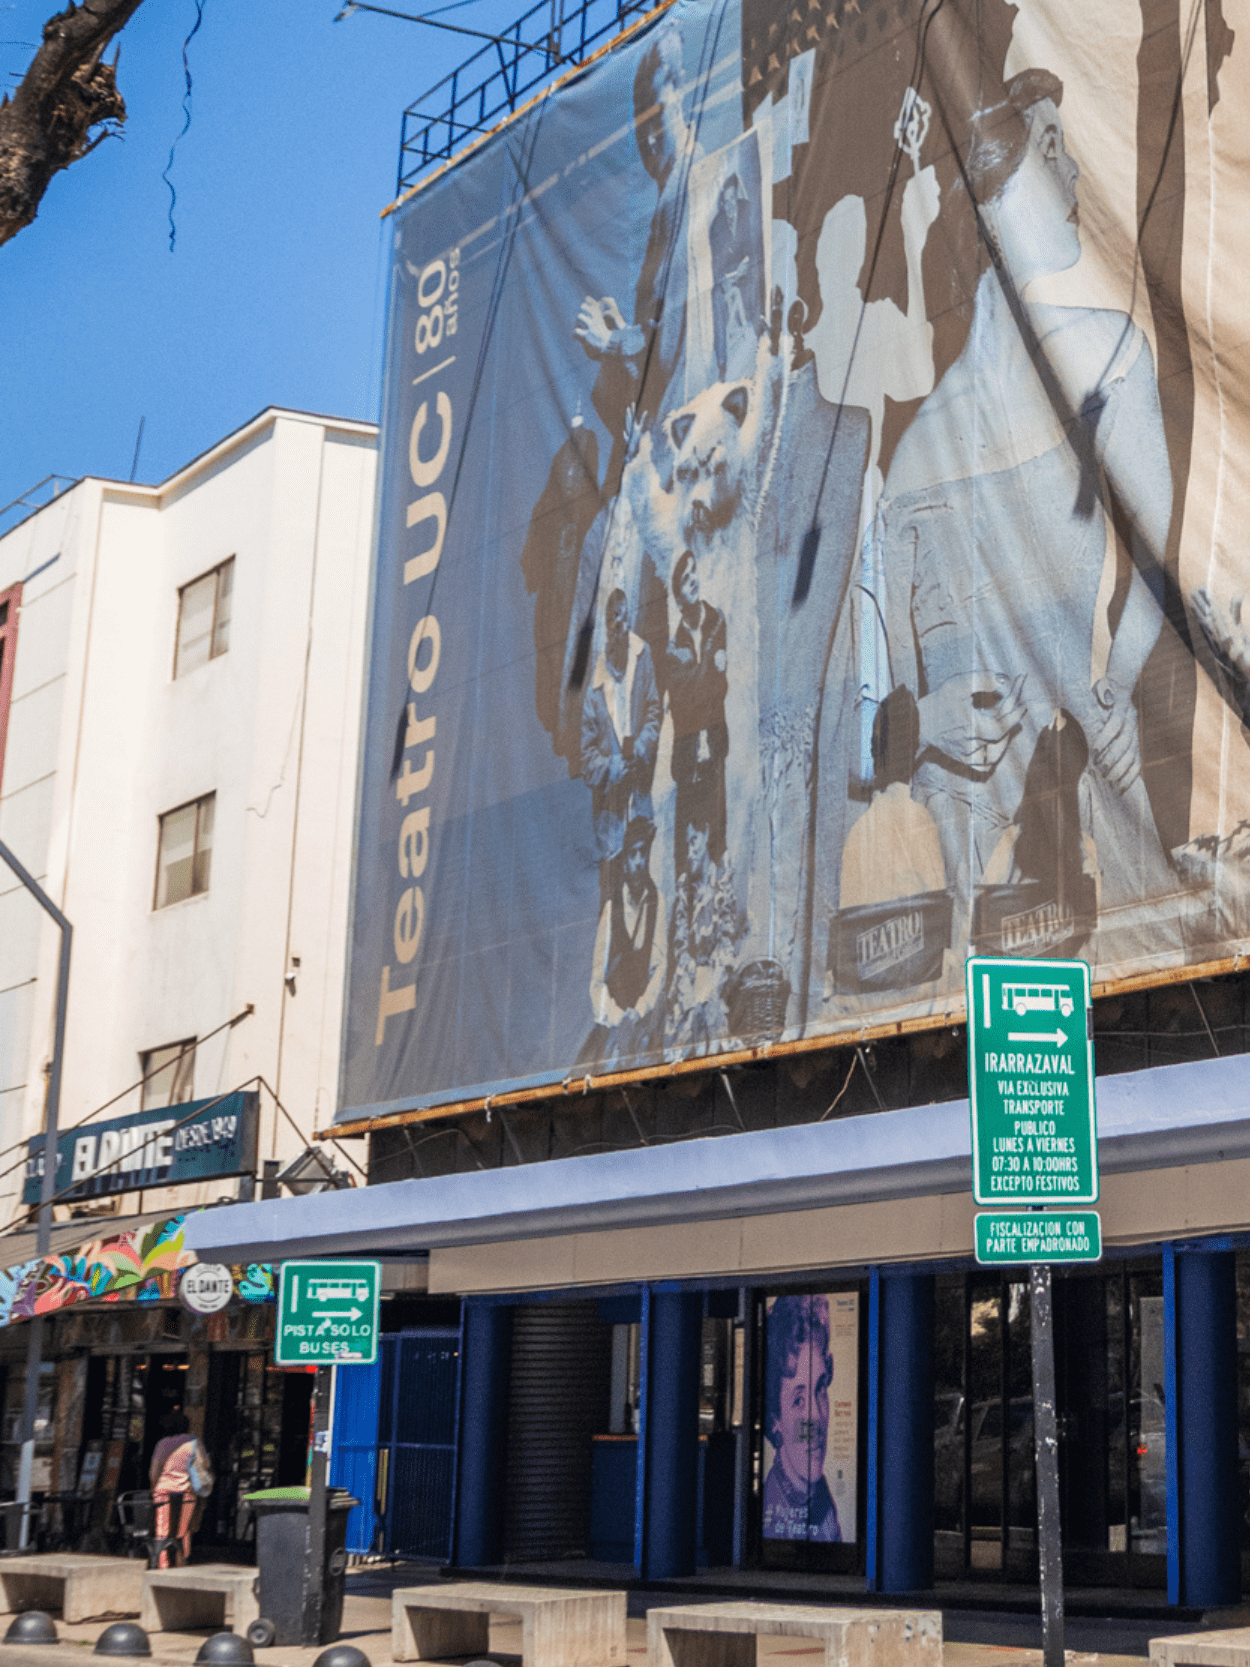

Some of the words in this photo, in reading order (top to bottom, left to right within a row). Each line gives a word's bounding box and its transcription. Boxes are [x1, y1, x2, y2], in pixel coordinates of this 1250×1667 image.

[446, 247, 460, 336] años
[415, 260, 446, 354] 80
[404, 389, 452, 585] UC
[374, 614, 441, 1046] Teatro
[860, 911, 920, 964] TEATRO
[985, 1052, 1075, 1075] IRARRAZAVAL
[997, 1080, 1015, 1095] VIA
[1017, 1081, 1070, 1096] EXCLUSIVA
[1003, 1100, 1065, 1116] TRANSPORTE
[1014, 1120, 1056, 1136] PUBLICO
[993, 1137, 1025, 1152] LUNES
[1026, 1138, 1035, 1152] A
[1035, 1137, 1075, 1152] VIERNES
[992, 1157, 1020, 1172] 07:30
[1022, 1157, 1031, 1171] A
[1033, 1156, 1078, 1172] 10:00HRS
[991, 1175, 1034, 1191] EXCEPTO
[1035, 1175, 1080, 1191] FESTIVOS
[990, 1221, 1061, 1237] FISCALIZACION
[1065, 1221, 1085, 1236] CON
[986, 1237, 1017, 1252] PARTE
[1021, 1236, 1090, 1252] EMPADRONADO
[187, 1280, 197, 1294] EL
[199, 1280, 229, 1294] DANTE
[283, 1324, 325, 1337] PISTA
[330, 1324, 371, 1336] SOLO
[299, 1341, 350, 1354] BUSES
